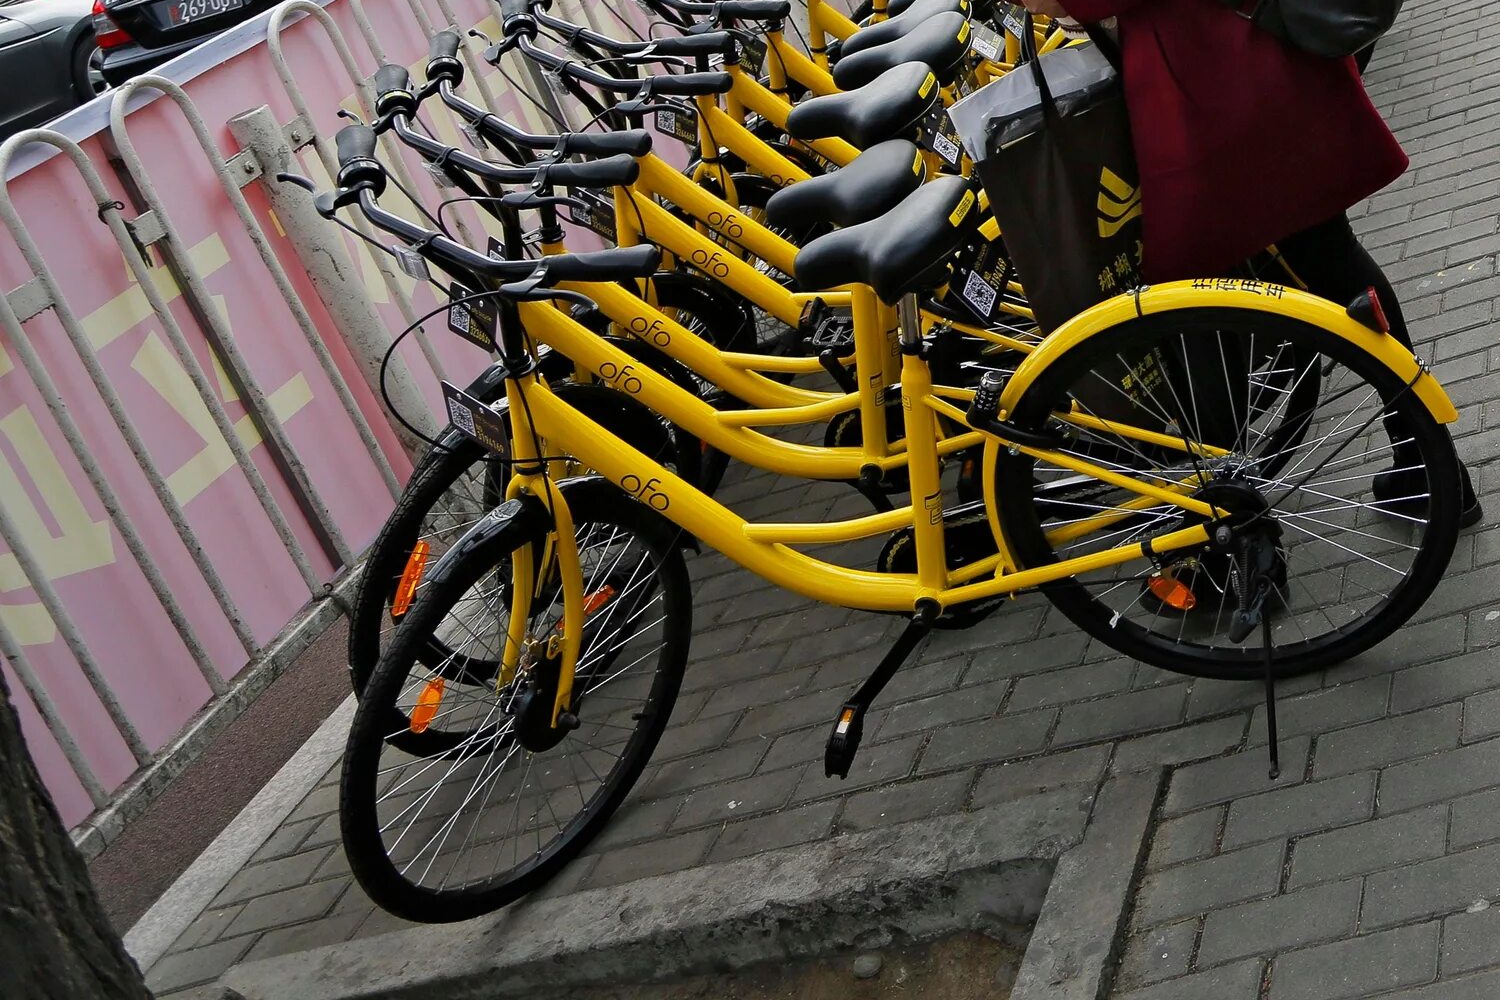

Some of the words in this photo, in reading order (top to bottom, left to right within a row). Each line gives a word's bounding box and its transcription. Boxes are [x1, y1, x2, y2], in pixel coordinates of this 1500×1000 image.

[707, 211, 743, 239] ofo
[692, 249, 729, 278] ofo
[631, 317, 671, 347] ofo
[599, 362, 642, 394] ofo
[620, 474, 670, 511] ofo
